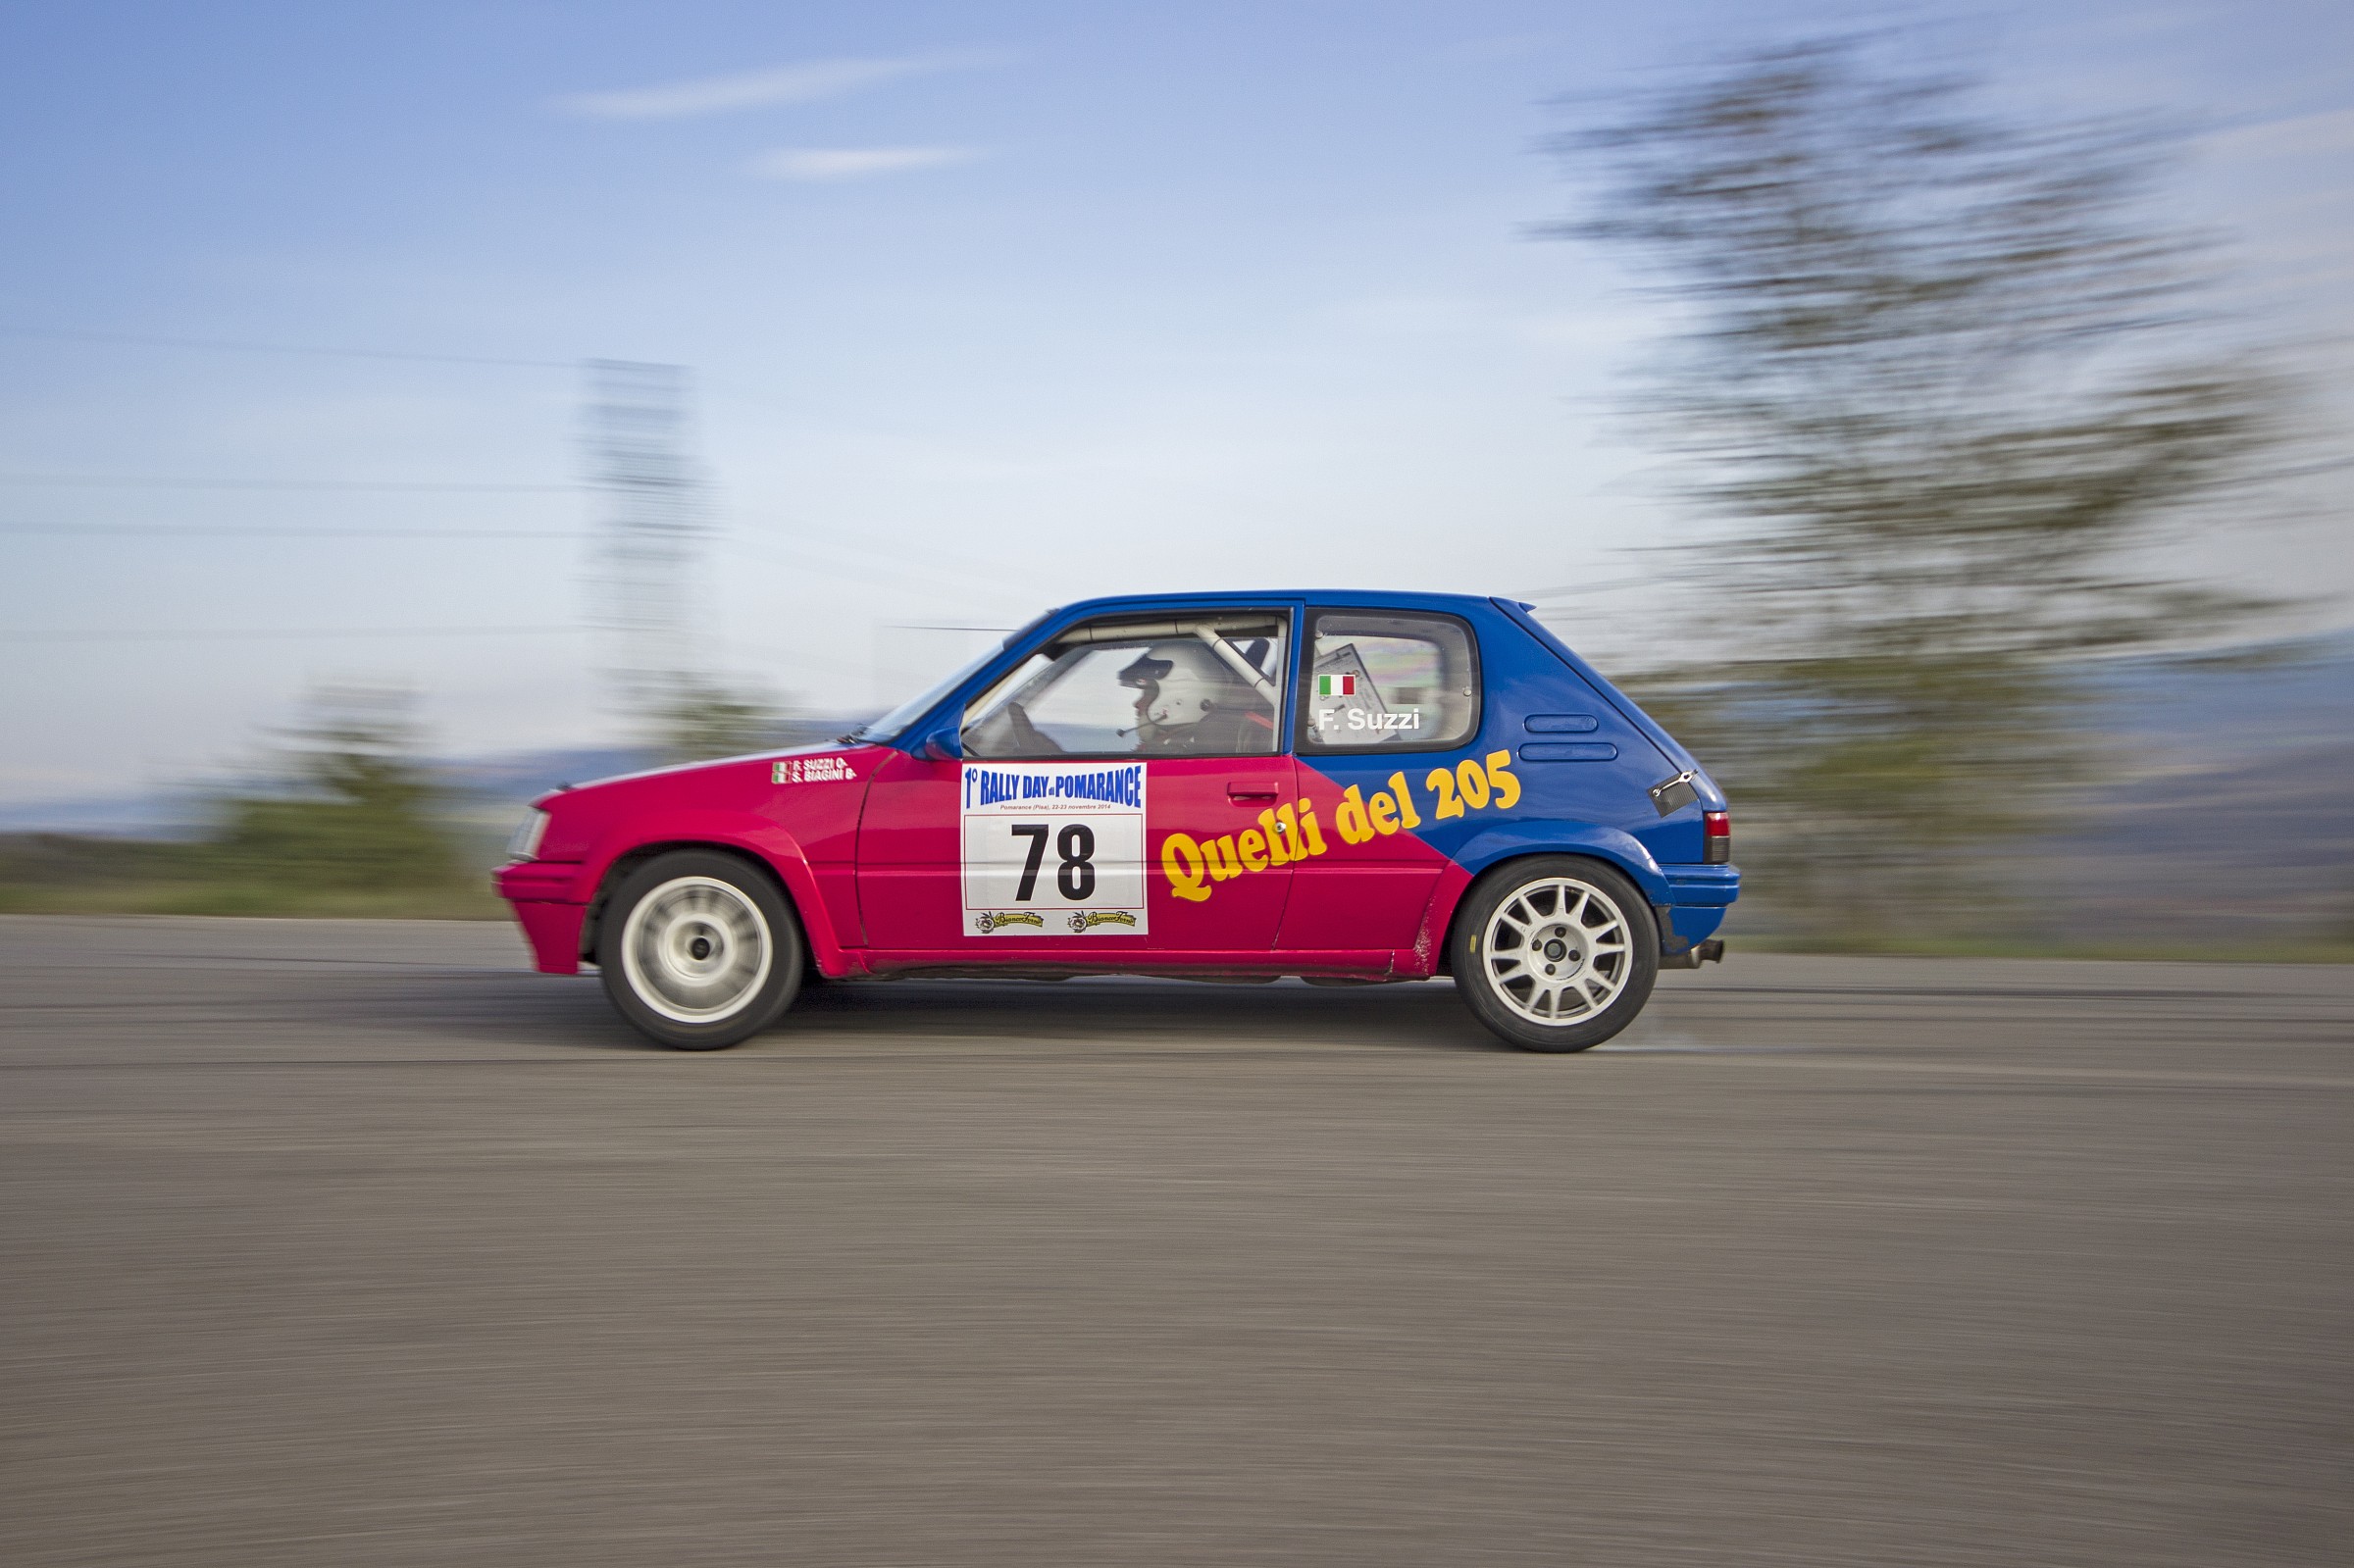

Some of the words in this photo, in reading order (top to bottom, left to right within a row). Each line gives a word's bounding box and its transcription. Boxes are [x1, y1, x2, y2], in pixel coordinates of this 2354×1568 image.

[1317, 708, 1340, 731] F.
[1347, 707, 1420, 731] Suzzi
[803, 757, 835, 771] SUZZI
[804, 768, 844, 783] BIAGINI
[980, 770, 1020, 806] RALLY
[1022, 775, 1049, 799] DAY
[1055, 765, 1142, 809] POMARANCE
[1161, 797, 1327, 902] Quelli
[1335, 771, 1421, 845] del
[1426, 749, 1521, 820] 205
[1011, 824, 1096, 902] 78
